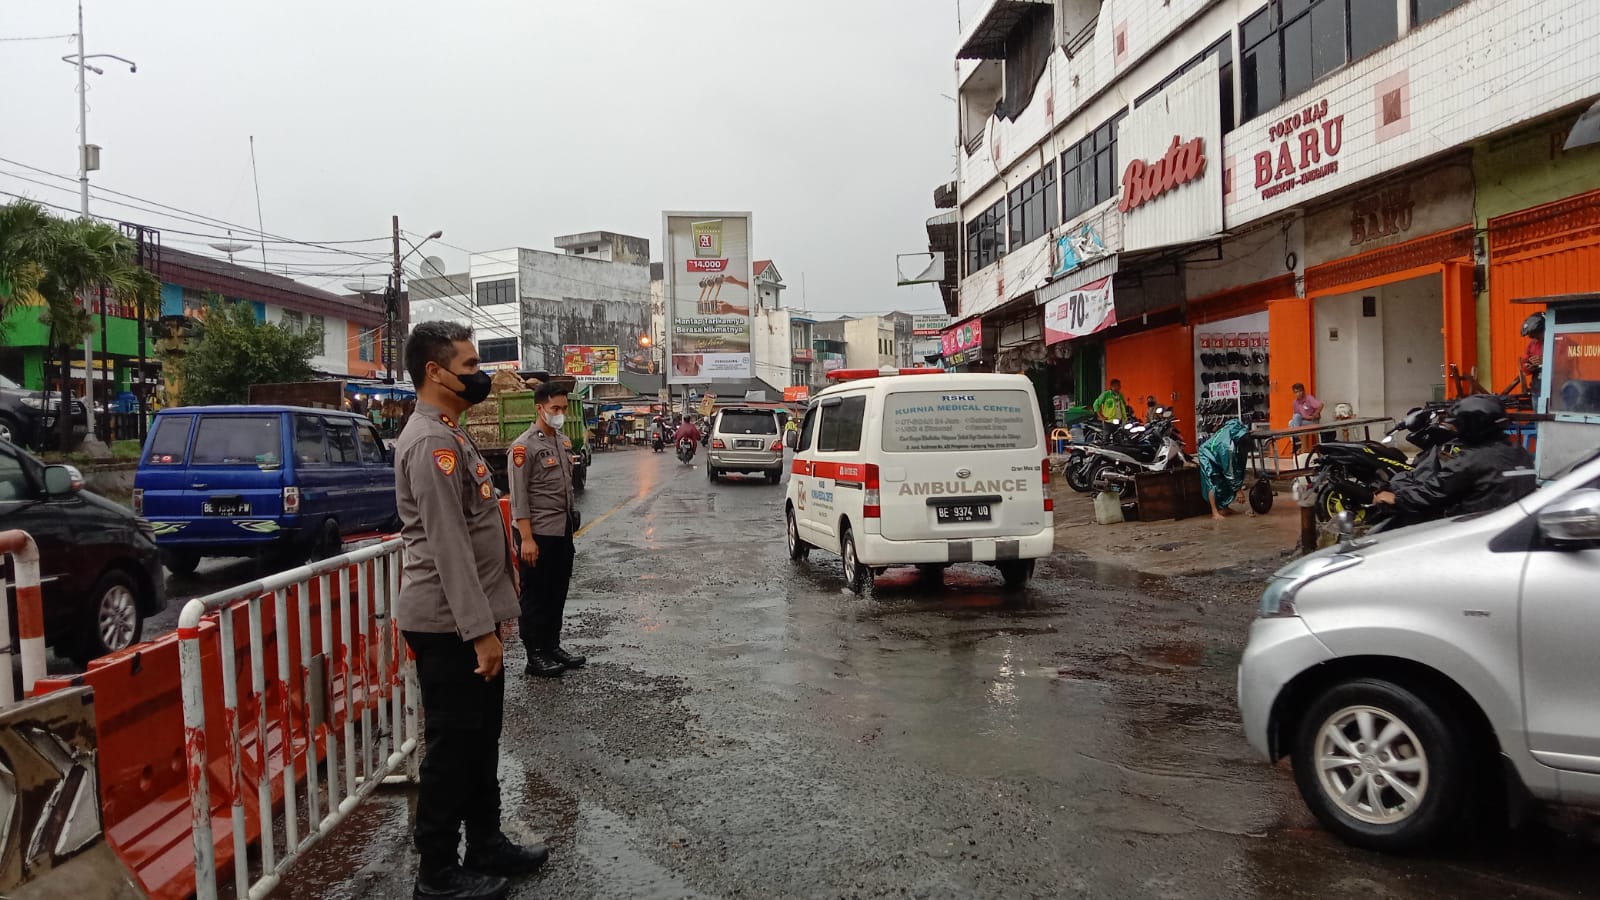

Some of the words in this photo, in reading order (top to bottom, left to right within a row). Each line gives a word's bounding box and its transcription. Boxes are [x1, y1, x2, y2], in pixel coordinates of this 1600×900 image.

[1269, 113, 1301, 142] TOKO
[1302, 99, 1328, 126] MAS
[1254, 114, 1344, 189] BARU
[1118, 134, 1206, 213] Bata
[694, 260, 721, 268] 14.000
[1069, 292, 1085, 329] 70
[704, 317, 744, 326] Tarikannya
[703, 325, 743, 334] Nikmatnya
[1568, 345, 1582, 357] NASI
[895, 406, 935, 416] KURNIA
[937, 404, 980, 412] MEDICAL
[983, 405, 1022, 413] CENTER
[899, 480, 1028, 496] AMBULANCE
[939, 507, 950, 518] BE
[953, 506, 973, 517] 9374
